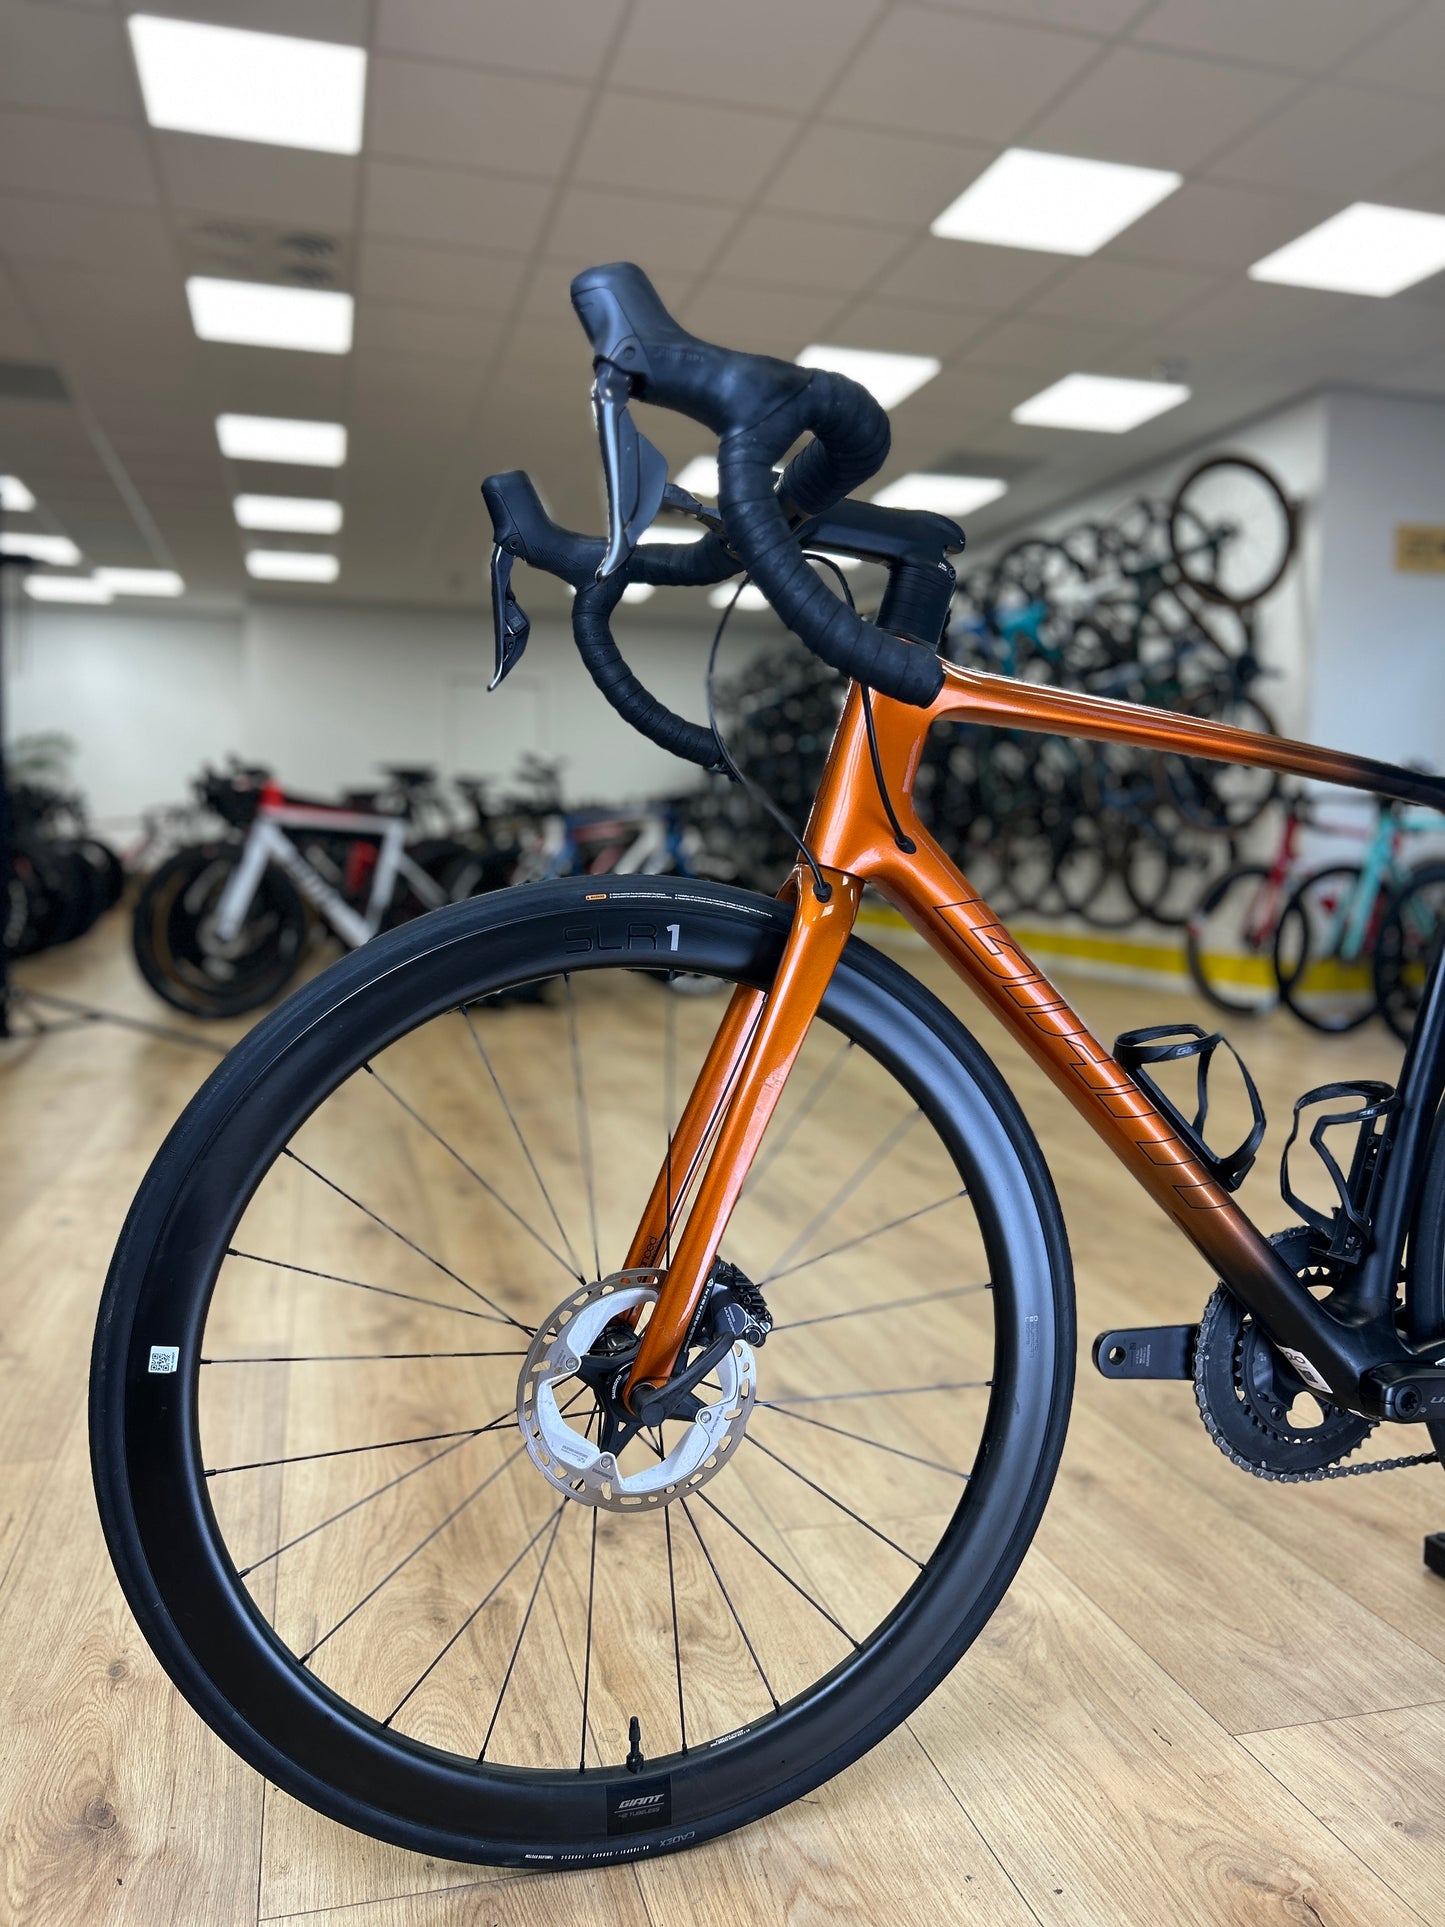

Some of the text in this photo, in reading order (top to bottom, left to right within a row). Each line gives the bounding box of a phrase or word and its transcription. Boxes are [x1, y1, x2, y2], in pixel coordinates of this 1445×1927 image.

[564, 922, 657, 954] SLR
[619, 1793, 665, 1809] GIANT
[659, 1830, 696, 1848] CADEX
